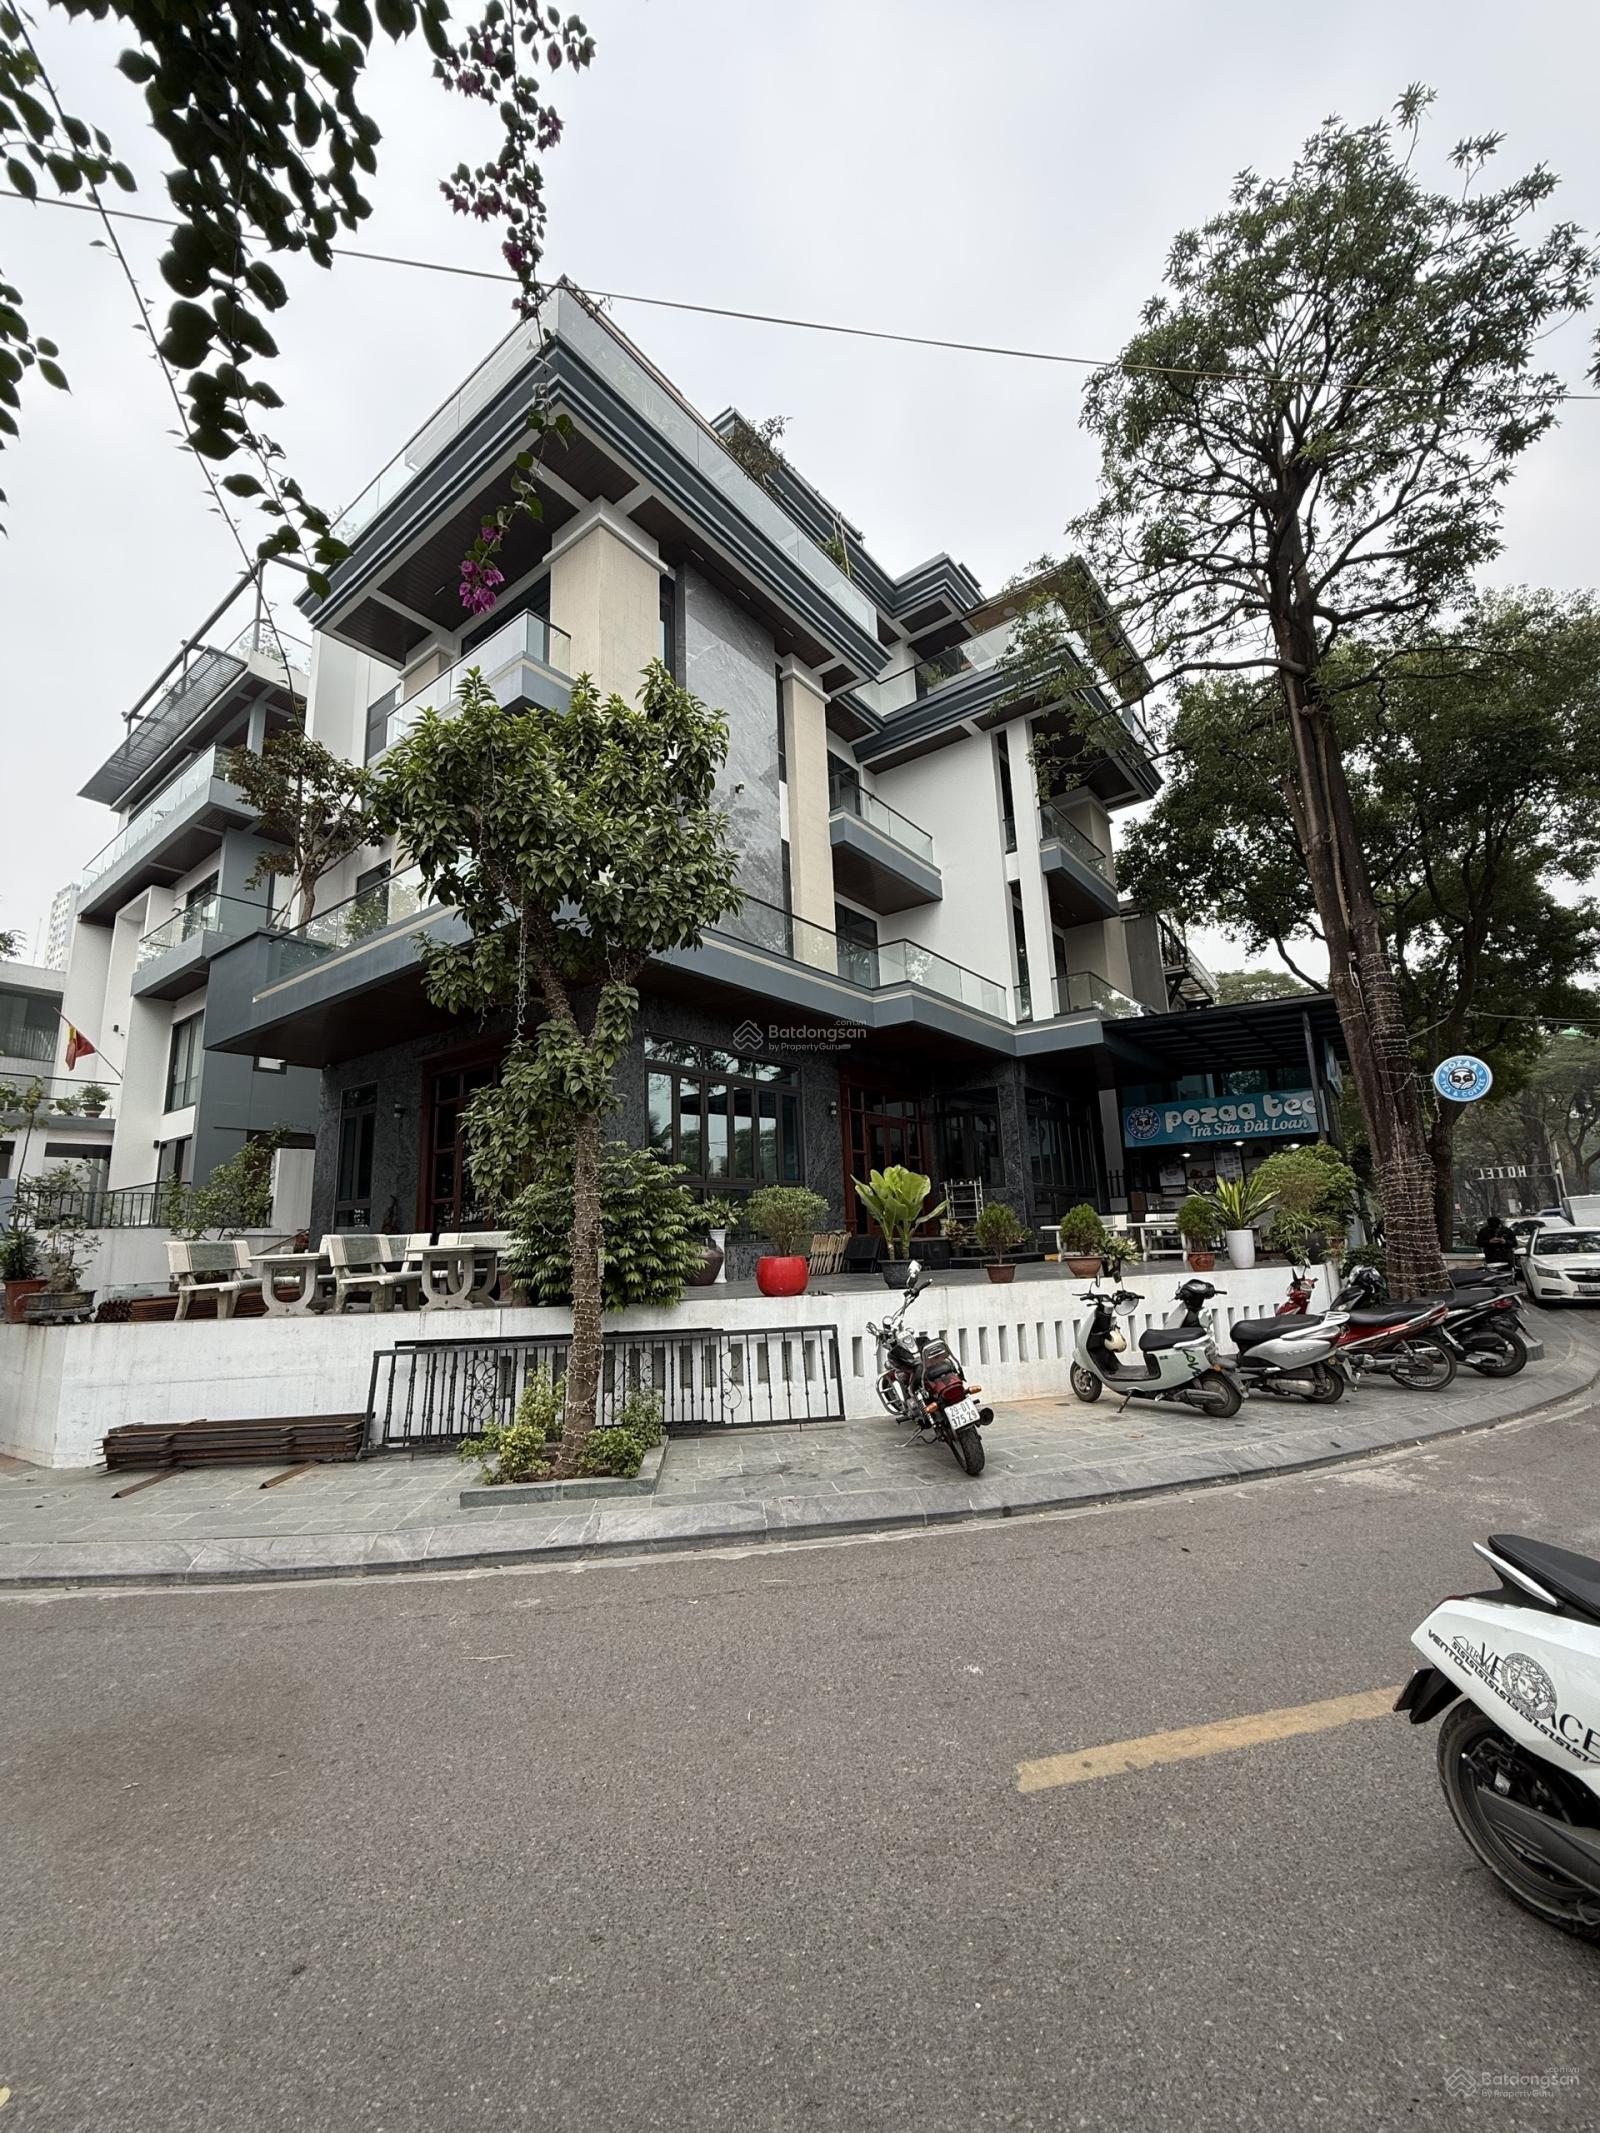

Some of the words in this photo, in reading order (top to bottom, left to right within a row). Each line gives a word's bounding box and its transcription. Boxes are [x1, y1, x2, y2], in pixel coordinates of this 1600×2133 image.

[1443, 1060, 1478, 1072] POZAA
[1164, 1102, 1256, 1133] pozaa
[1190, 1125, 1212, 1138] Trà
[1214, 1119, 1241, 1135] Sữa
[1244, 1117, 1268, 1132] Đài
[1271, 1115, 1308, 1130] Loan
